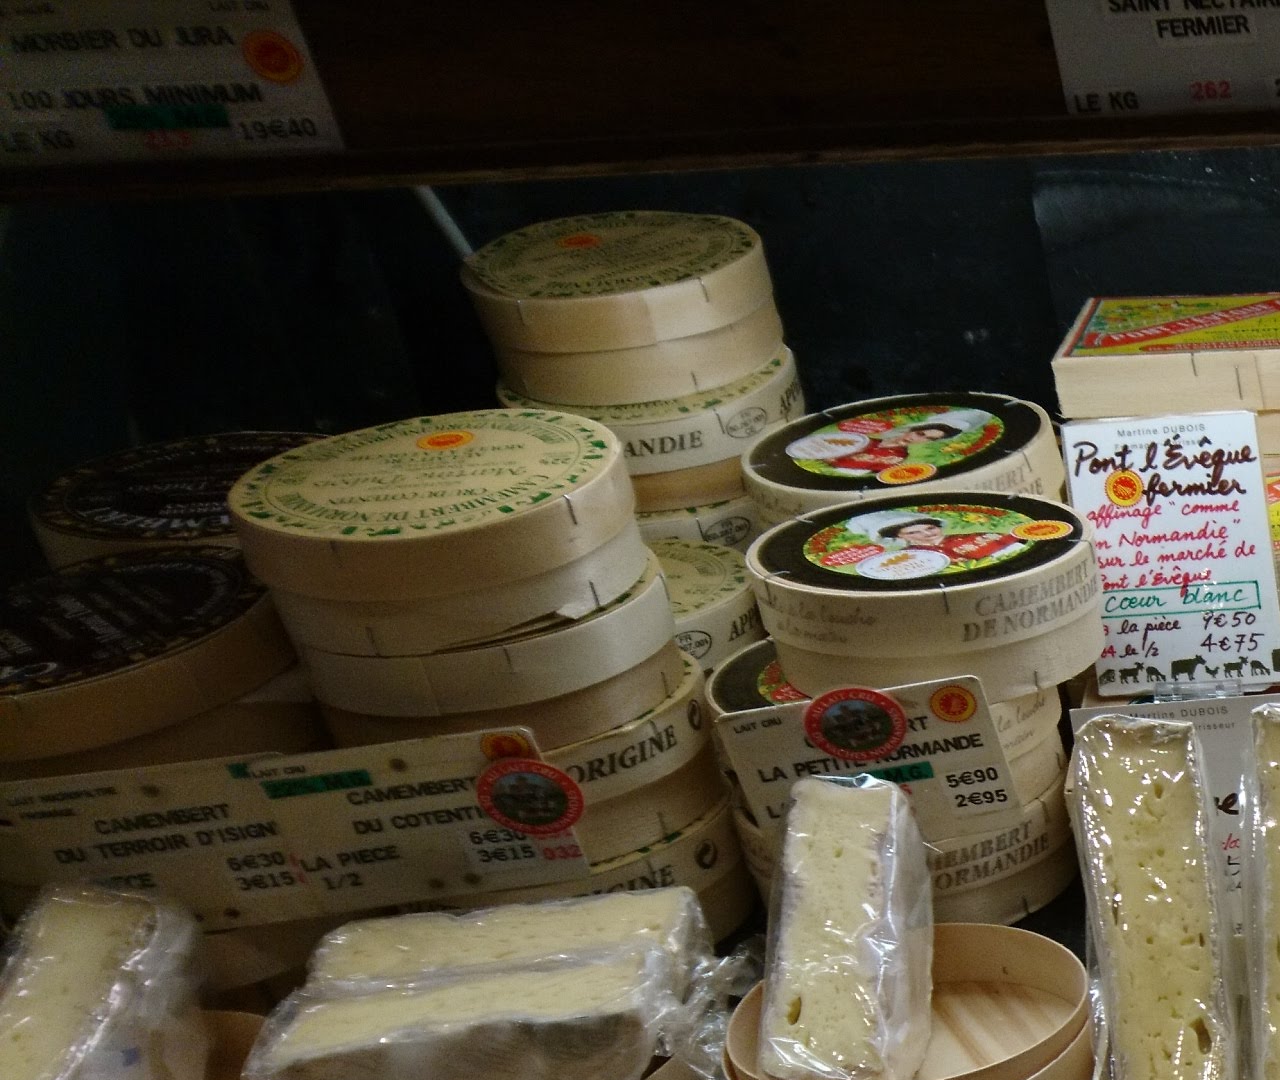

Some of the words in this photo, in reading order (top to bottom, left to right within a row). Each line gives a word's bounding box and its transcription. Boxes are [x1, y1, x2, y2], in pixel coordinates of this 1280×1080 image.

[1156, 15, 1250, 38] FERMIER
[127, 28, 162, 47] DU
[1190, 81, 1232, 100] 262
[1074, 95, 1100, 112] LE
[1108, 92, 1139, 110] KG
[1117, 429, 1158, 438] Martine
[1163, 423, 1206, 434] DUBOIS
[1073, 441, 1134, 477] Pont
[1142, 472, 1247, 506] fermier
[1087, 504, 1162, 529] affinage
[1129, 551, 1149, 566] le
[1157, 540, 1227, 563] marché
[1234, 541, 1256, 558] de
[1117, 619, 1139, 635] la
[1200, 633, 1265, 652] 4€75
[1181, 706, 1229, 717] DUBOIS
[758, 767, 787, 783] LA
[947, 767, 998, 788] 5€90
[346, 776, 477, 805] CAMEMBERT
[956, 789, 1008, 808] 2€95
[94, 803, 229, 834] CAMEMBERT
[352, 818, 384, 834] DU
[93, 834, 190, 859] TERROIR
[337, 845, 400, 867] PIECE
[479, 846, 536, 863] 3€15
[226, 851, 286, 871] 6€30
[235, 871, 296, 891] 3€15
